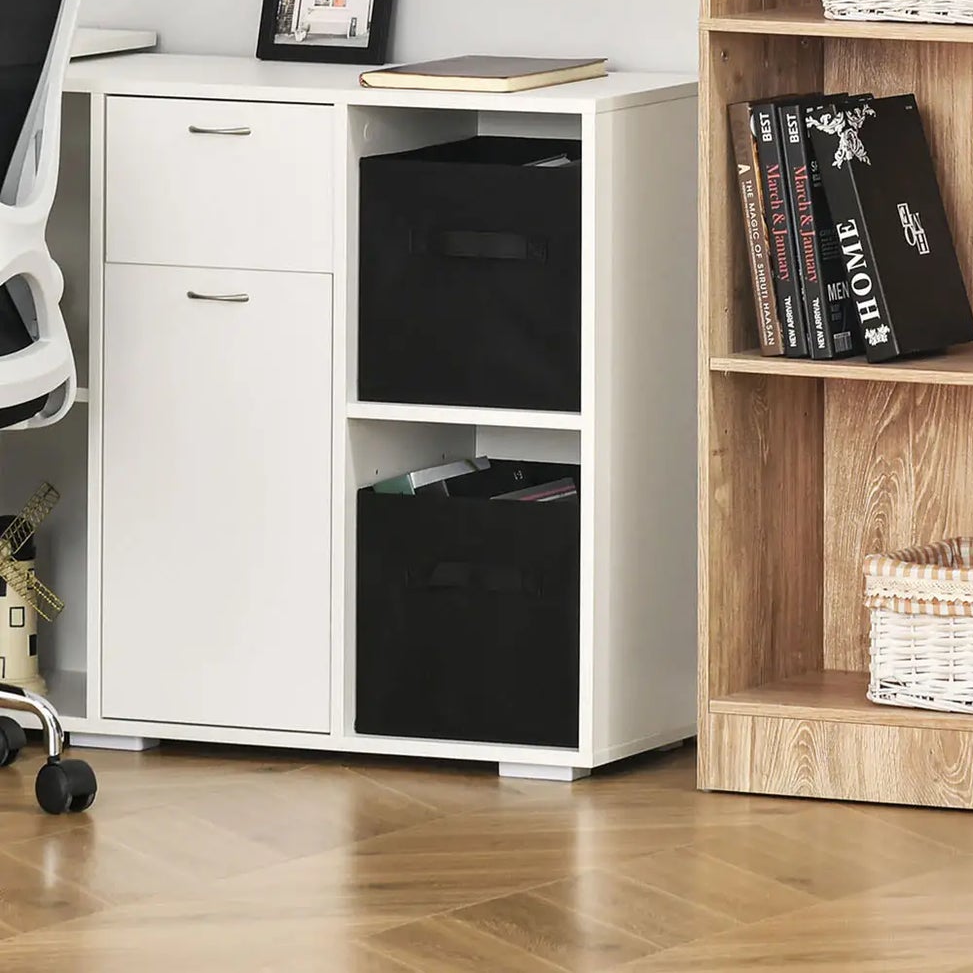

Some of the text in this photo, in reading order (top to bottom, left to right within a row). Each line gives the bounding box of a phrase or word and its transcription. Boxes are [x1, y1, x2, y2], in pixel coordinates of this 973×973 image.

[761, 112, 773, 142] BEST
[788, 113, 800, 143] BEST
[745, 179, 754, 198] THE
[748, 202, 760, 240] MAGIC
[766, 163, 790, 282] March & January
[793, 165, 818, 284] March & January
[753, 244, 762, 258] OF
[836, 219, 881, 324] HOME
[827, 281, 850, 302] MEN
[764, 301, 775, 346] HAASAN
[784, 296, 797, 348] NEW ARRIVAL
[811, 297, 826, 349] NEW ARRIVAL
